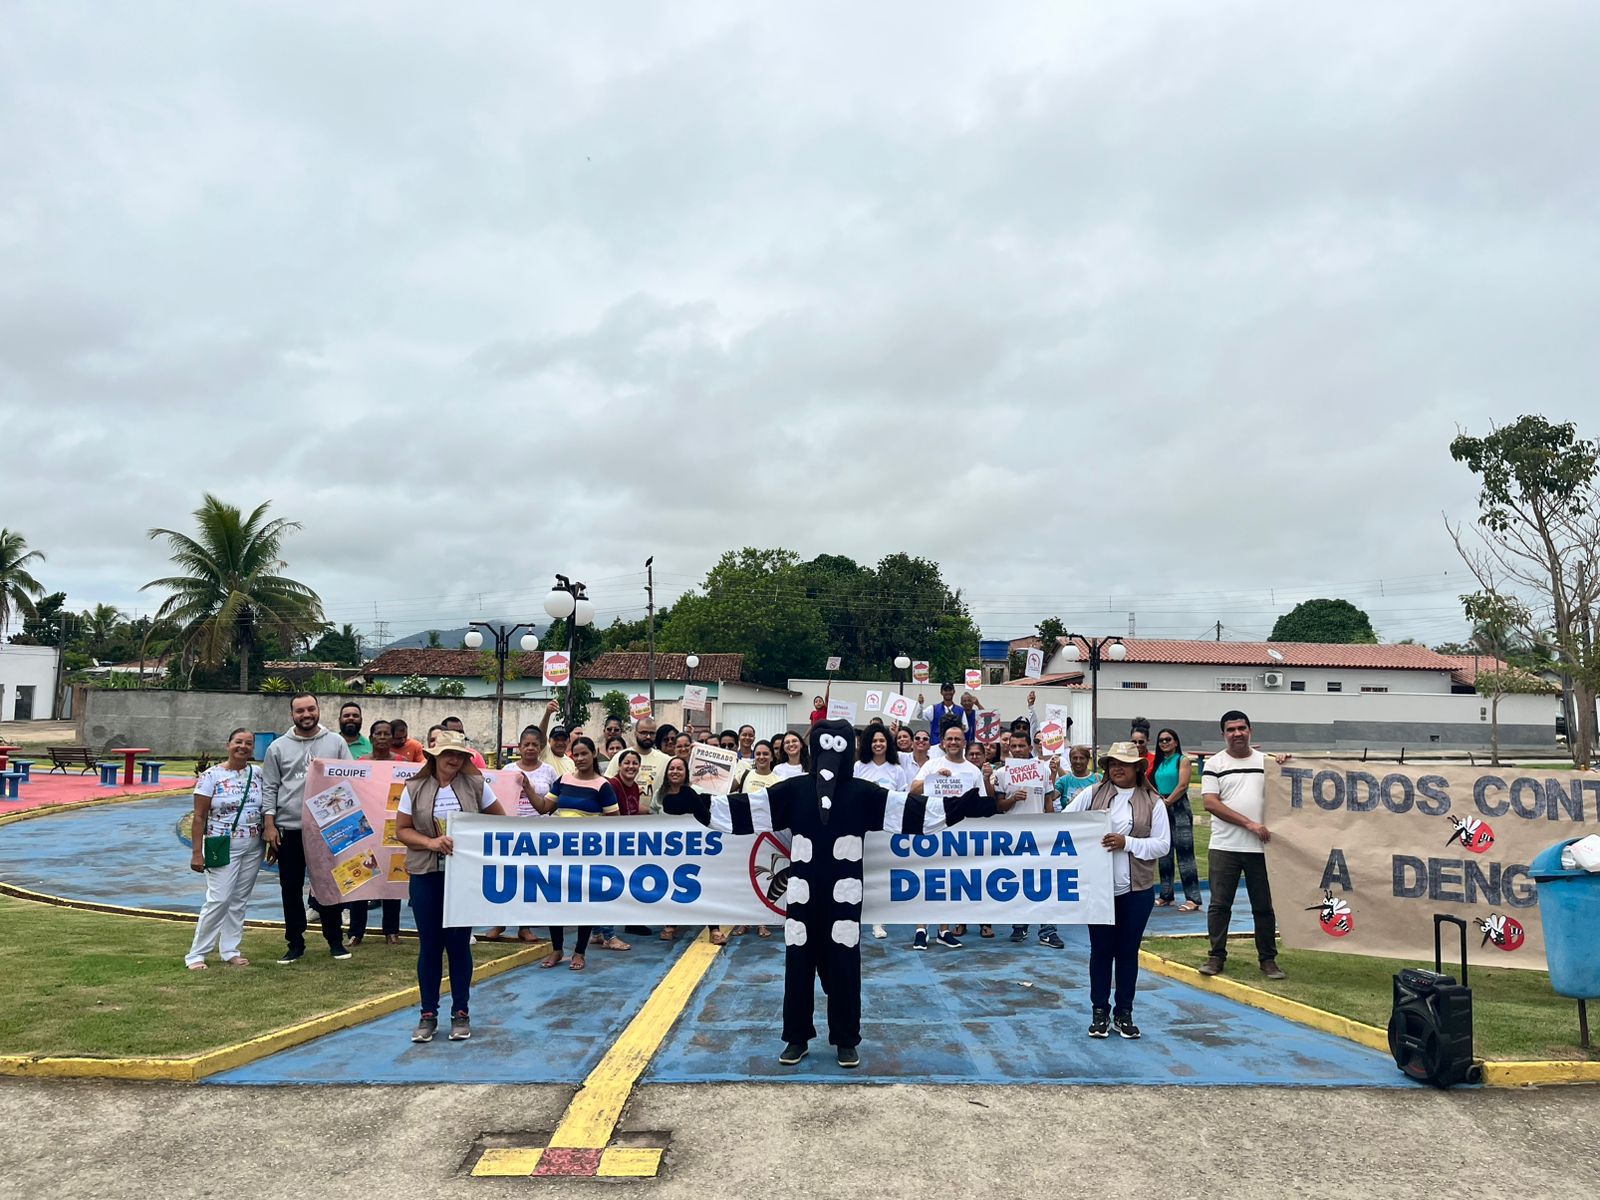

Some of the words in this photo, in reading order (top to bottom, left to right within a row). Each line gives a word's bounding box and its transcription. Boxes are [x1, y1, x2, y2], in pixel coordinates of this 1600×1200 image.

[696, 748, 734, 762] PROCURADO
[1009, 762, 1037, 775] DENGUE
[328, 768, 366, 777] EQUIPE
[1011, 770, 1041, 784] MATA
[1281, 766, 1451, 816] TODOS
[484, 831, 723, 858] ITAPEBIENSES
[890, 830, 1040, 858] CONTRA
[1051, 830, 1078, 857] A
[1319, 848, 1353, 892] A
[482, 863, 703, 905] UNIDOS
[890, 867, 1080, 903] DENGUE
